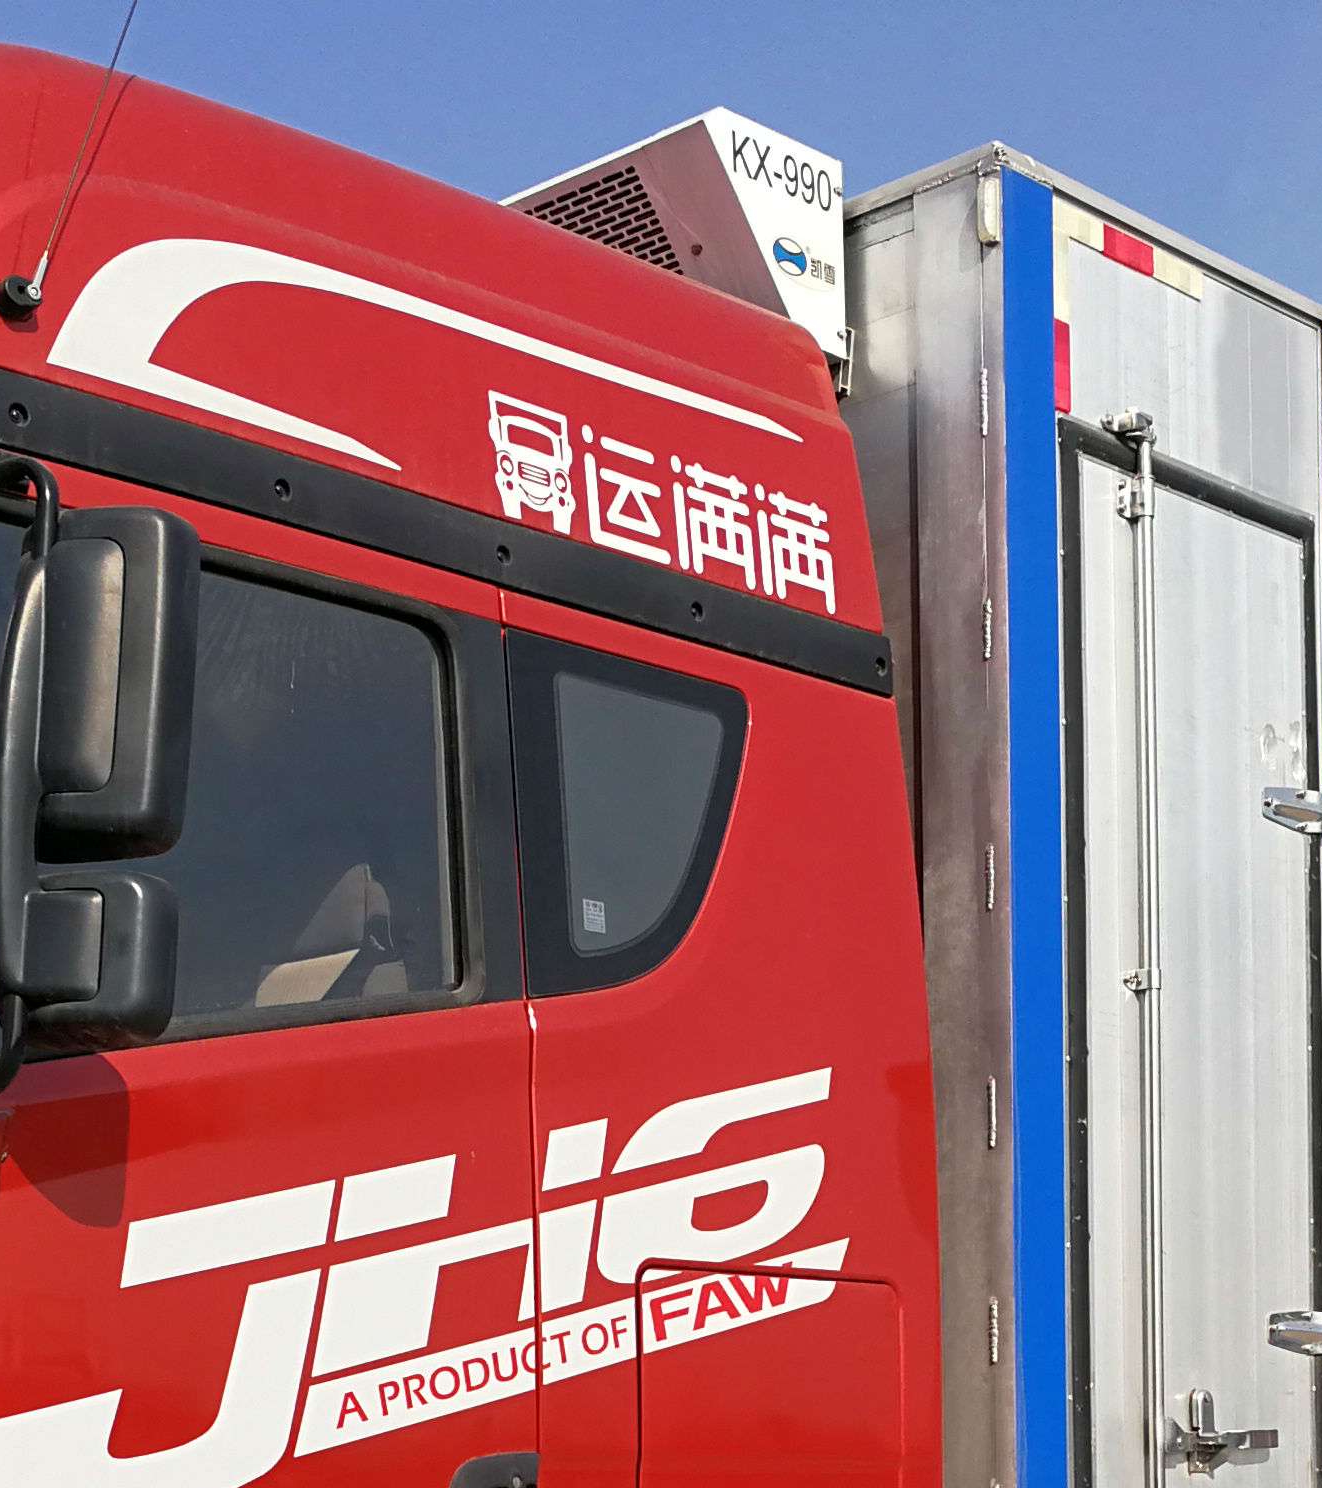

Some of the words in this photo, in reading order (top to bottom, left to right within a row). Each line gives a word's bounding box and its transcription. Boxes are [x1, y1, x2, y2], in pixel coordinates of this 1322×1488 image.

[731, 129, 832, 212] KX-990
[581, 424, 836, 615] 运满满
[335, 1390, 369, 1430] A
[378, 1330, 572, 1417] PRODUCT
[581, 1315, 628, 1356] OF
[648, 1262, 795, 1342] FAW
